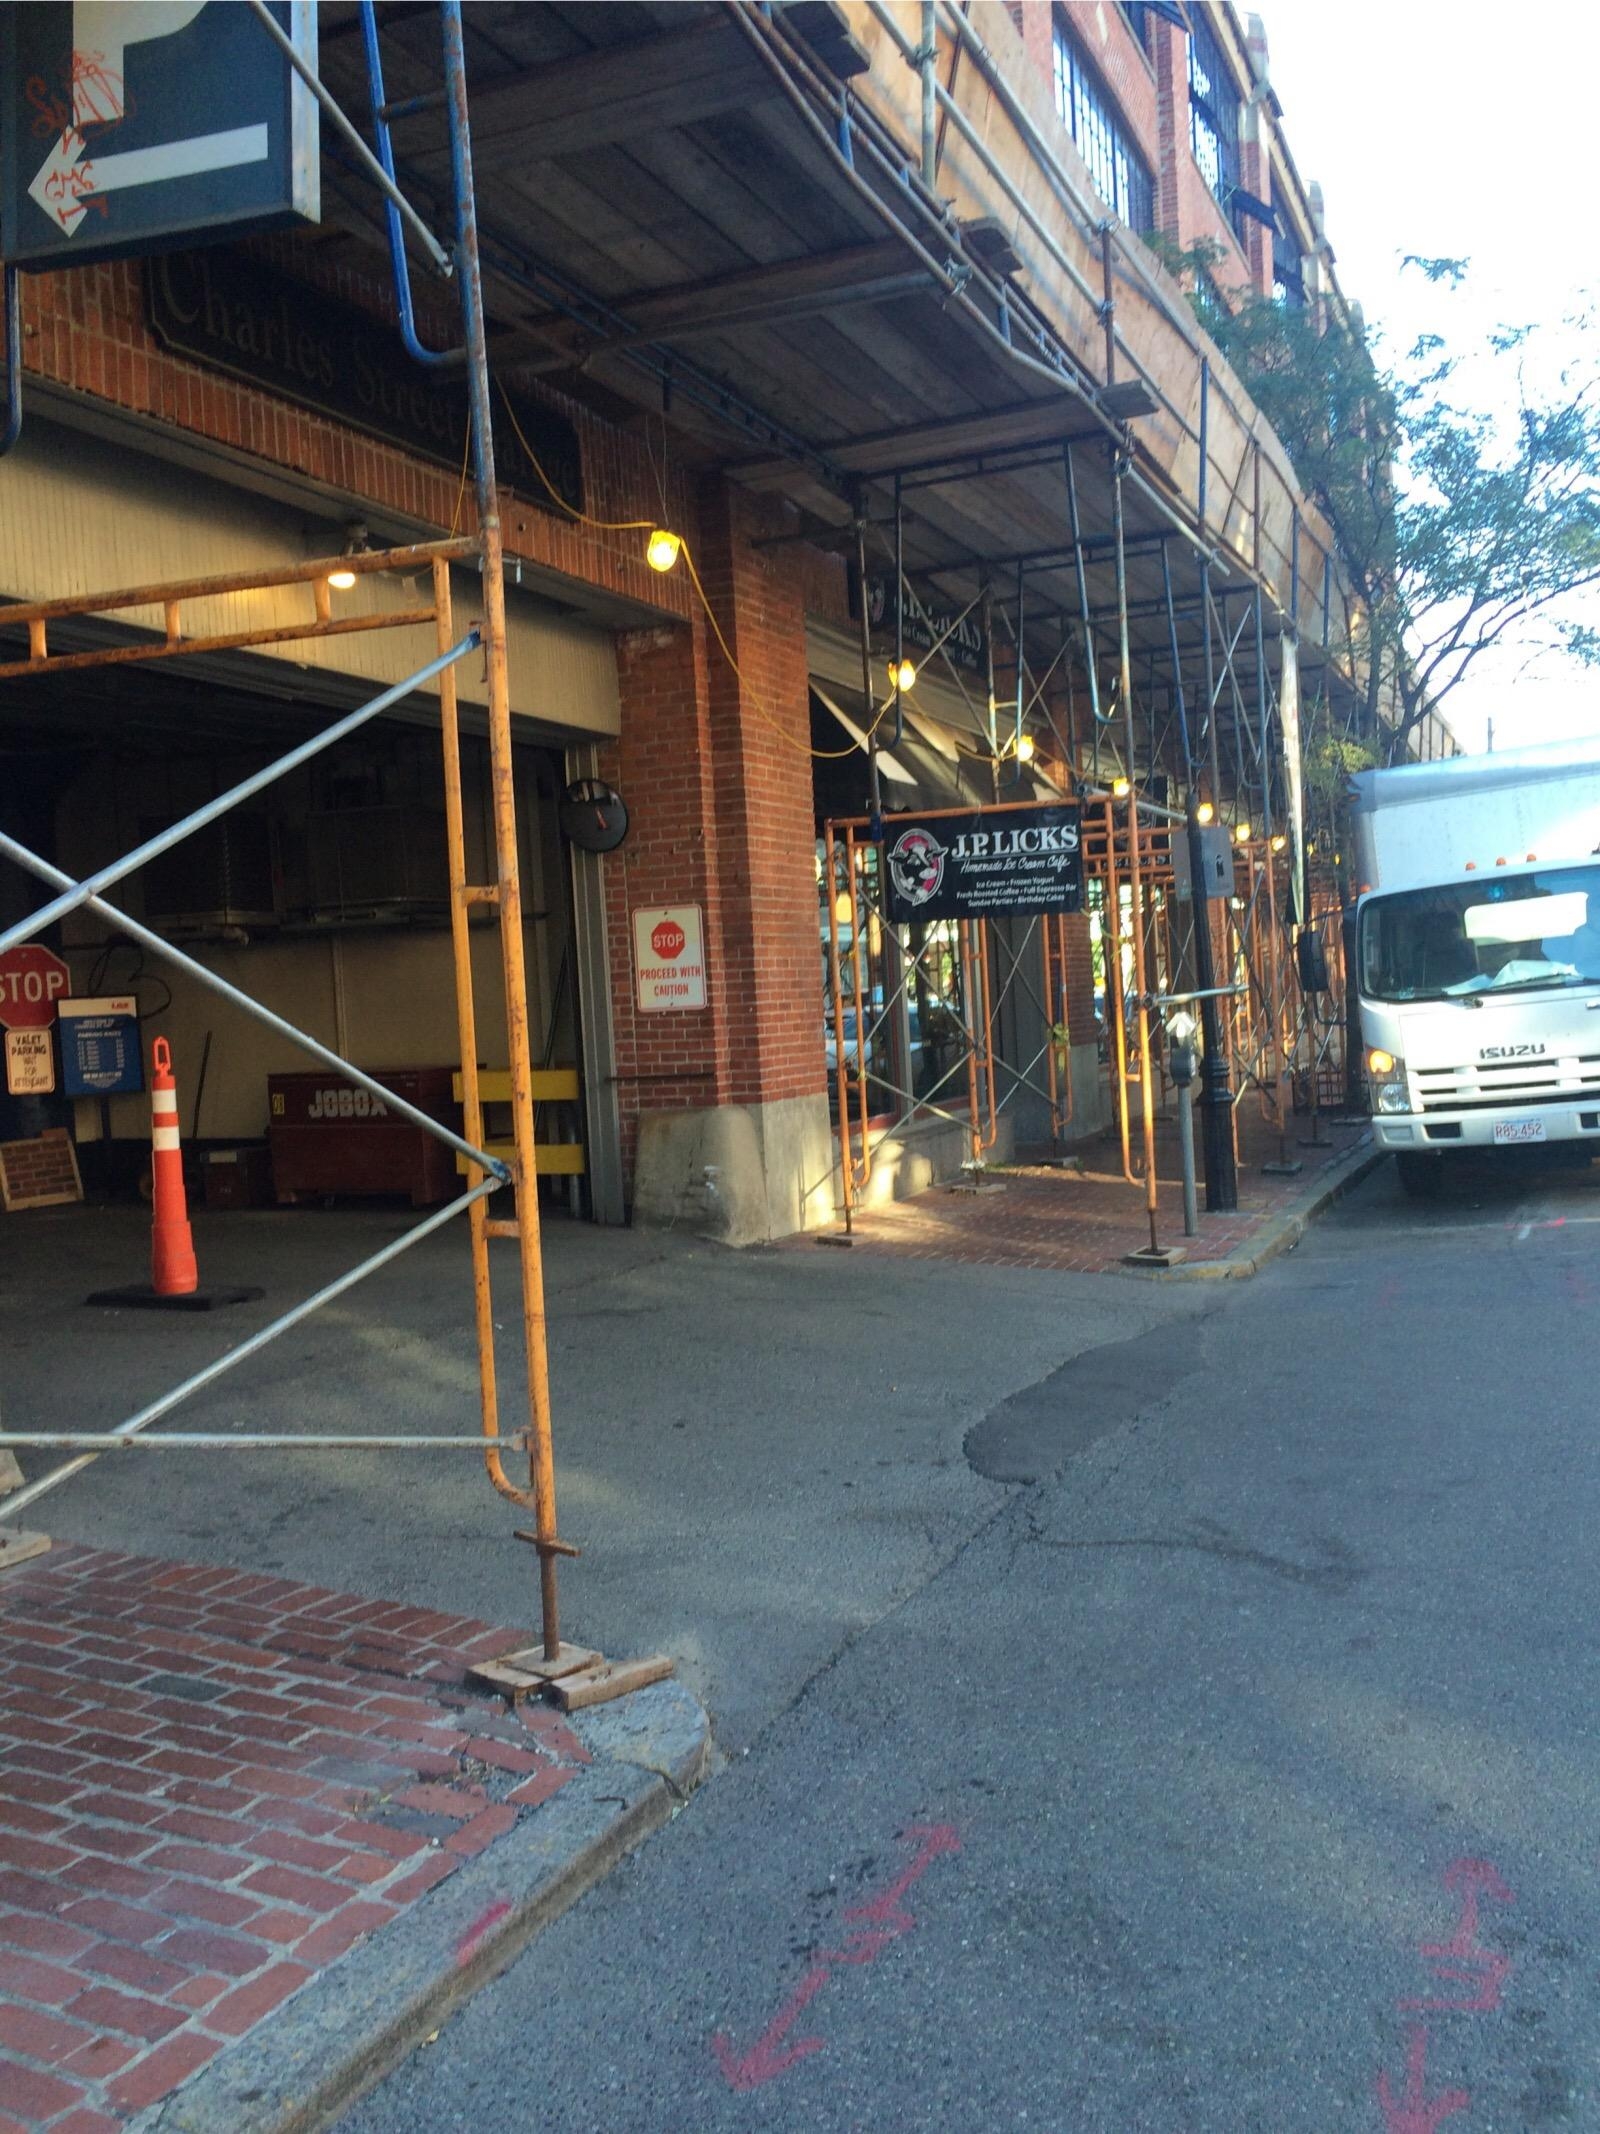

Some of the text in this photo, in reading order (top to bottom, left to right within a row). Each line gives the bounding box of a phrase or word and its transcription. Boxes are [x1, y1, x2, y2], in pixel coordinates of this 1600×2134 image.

[160, 257, 333, 388] Charles
[952, 824, 1078, 858] J.P. LICKS
[960, 859, 1002, 874] Homemade
[1002, 857, 1016, 871] Ice
[1018, 857, 1046, 870] Cream
[976, 875, 1054, 889] Ice Cream Frozen Yogurt
[957, 891, 972, 899] Fresh
[973, 889, 998, 897] Roasted
[999, 888, 1019, 896] Coffee
[1024, 886, 1036, 894] Full
[1036, 885, 1065, 894] Espresso
[968, 894, 1065, 907] Sundae Parties Birthday Cakes
[654, 934, 683, 948] STOP
[641, 965, 702, 980] PROCEED WITH
[654, 983, 689, 997] CAUTION
[16, 1034, 41, 1045] VALET
[11, 1044, 47, 1056] PARKING
[1479, 1043, 1546, 1059] ISUZU
[308, 1089, 387, 1119] JOBOX
